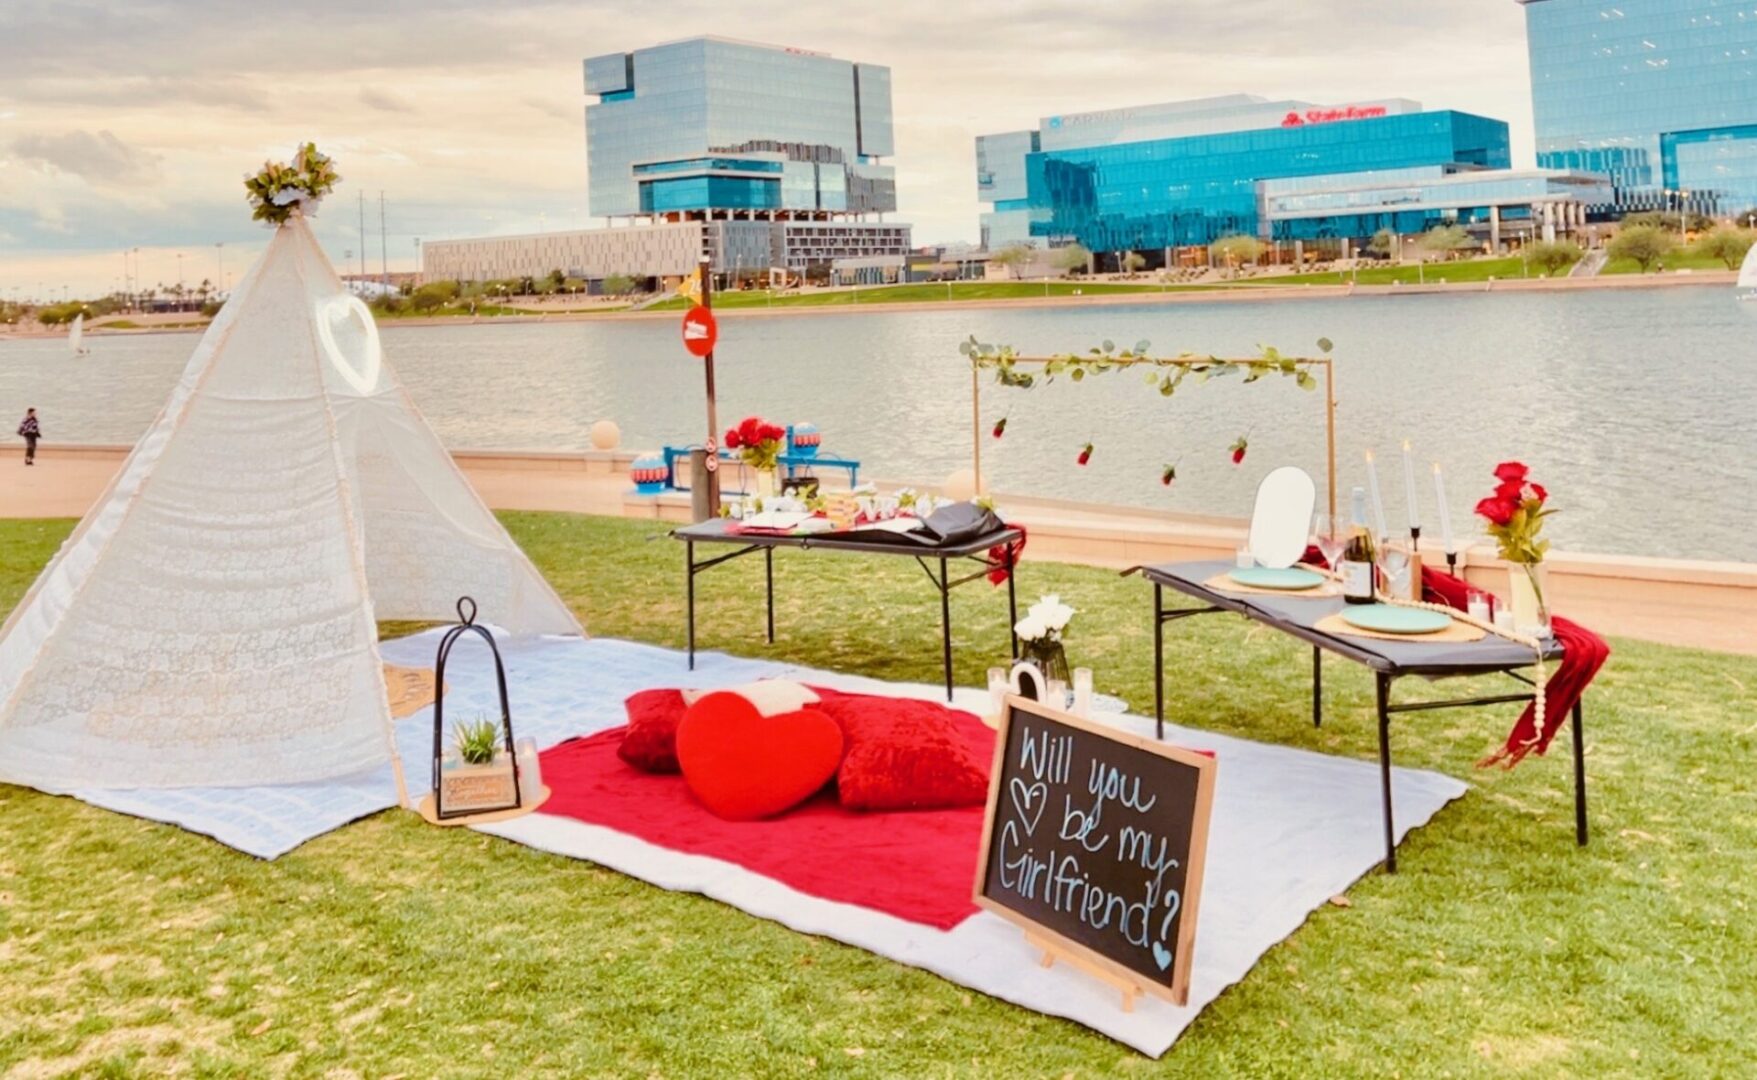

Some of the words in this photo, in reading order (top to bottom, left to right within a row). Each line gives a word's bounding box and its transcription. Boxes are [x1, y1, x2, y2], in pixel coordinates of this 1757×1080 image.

[1020, 726, 1073, 785] Will
[1088, 758, 1155, 832] you
[999, 820, 1181, 948] Girlfriend?
[1058, 793, 1110, 852] be
[1117, 825, 1180, 908] my
